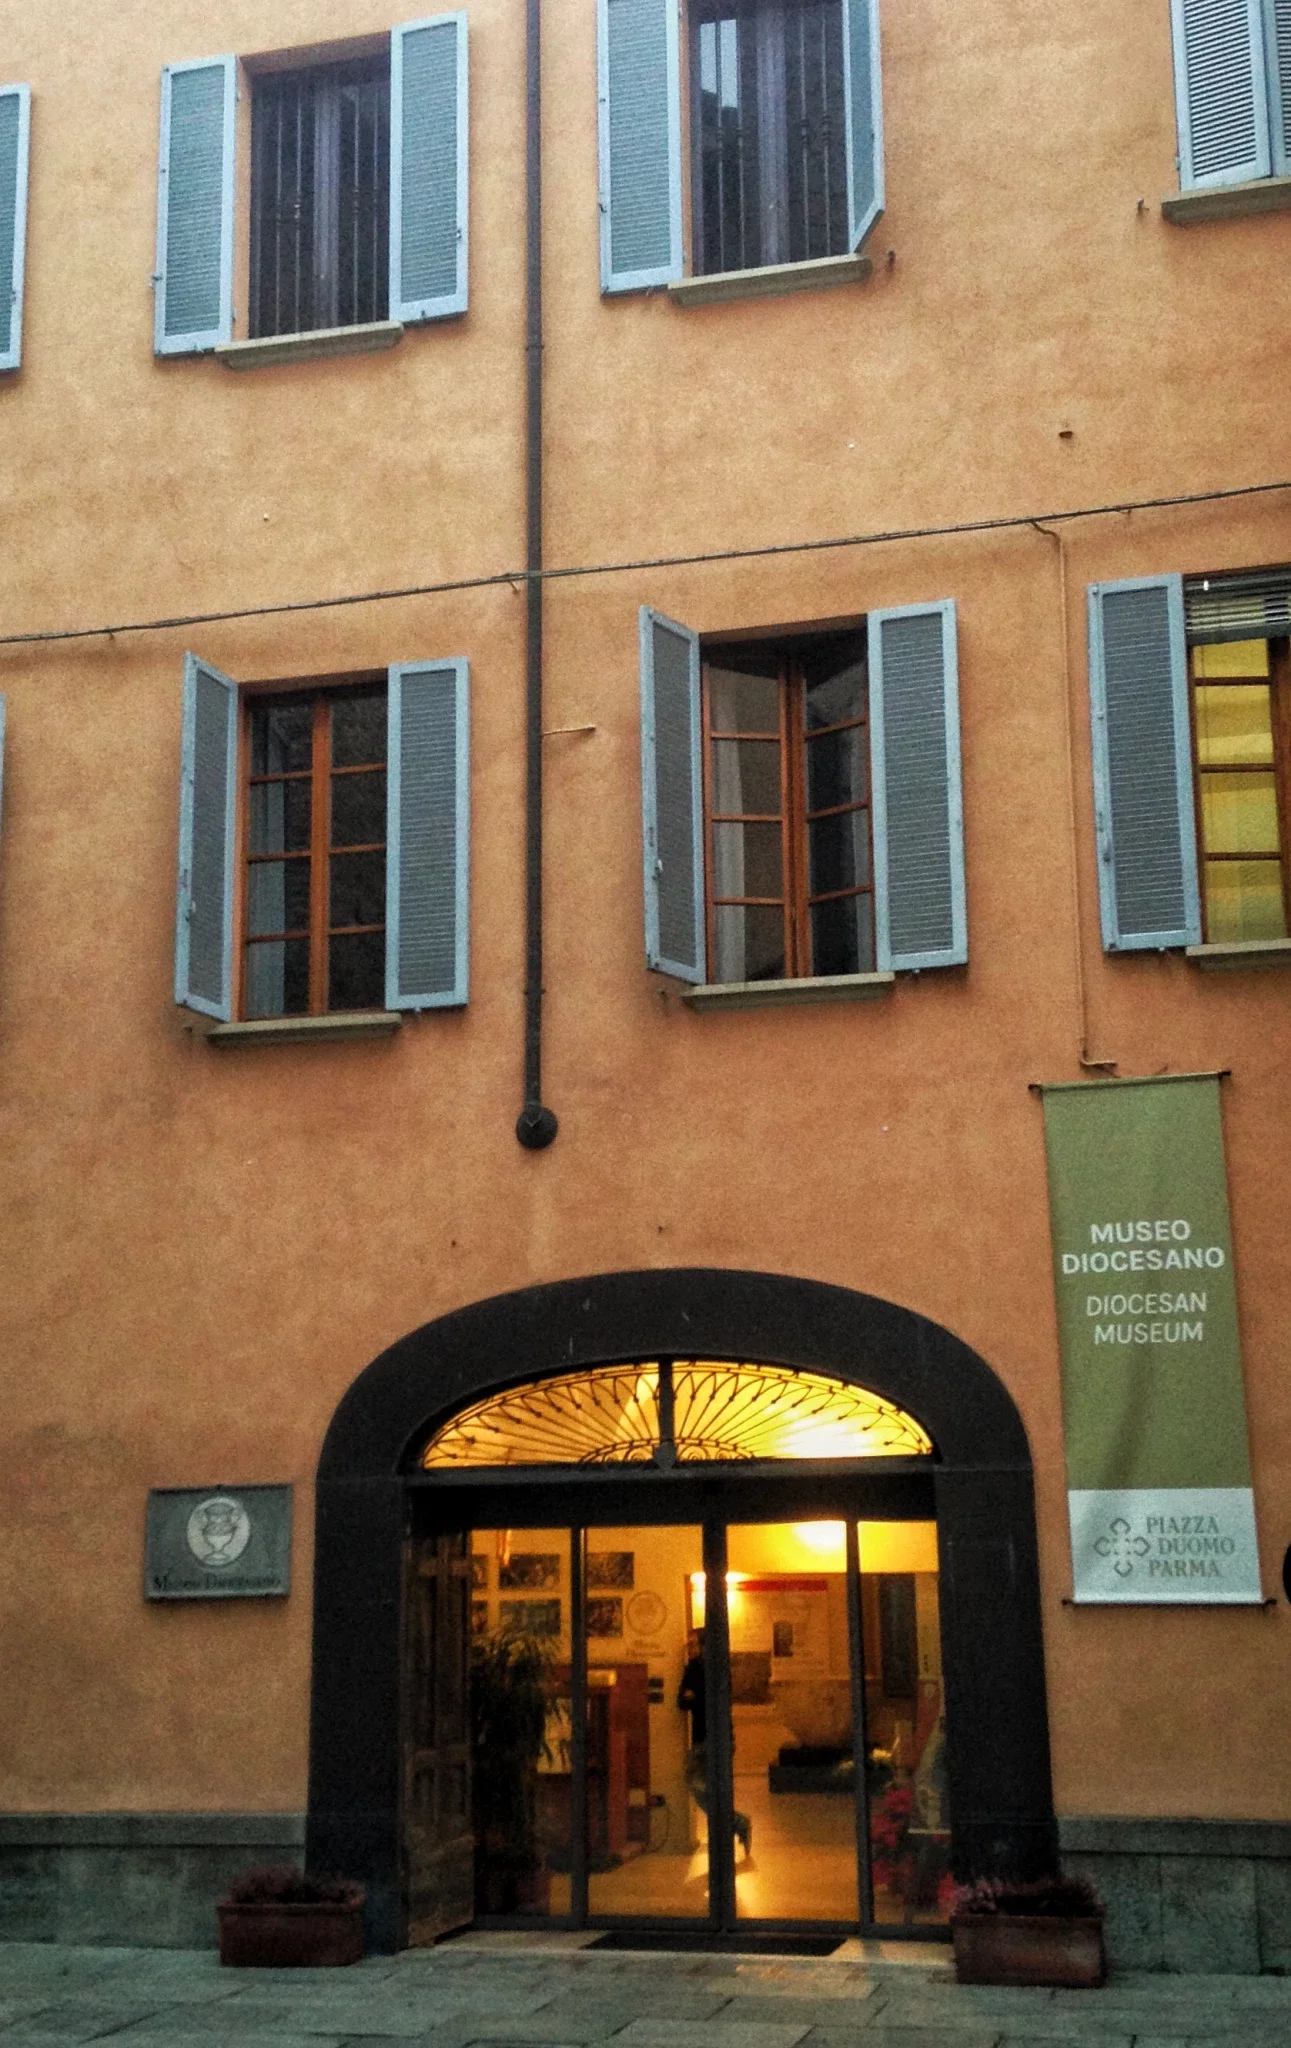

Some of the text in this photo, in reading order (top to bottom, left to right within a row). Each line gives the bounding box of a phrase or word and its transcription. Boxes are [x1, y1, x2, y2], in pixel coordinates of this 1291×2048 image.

[1091, 1219, 1191, 1244] MUSEO
[1062, 1247, 1226, 1274] DIOCESANO
[1086, 1293, 1207, 1316] DIOCESAN
[1094, 1322, 1204, 1345] MUSEUM
[1146, 1516, 1220, 1534] PIAZZA
[1158, 1537, 1236, 1555] DUOMO
[1149, 1559, 1221, 1577] PARMA
